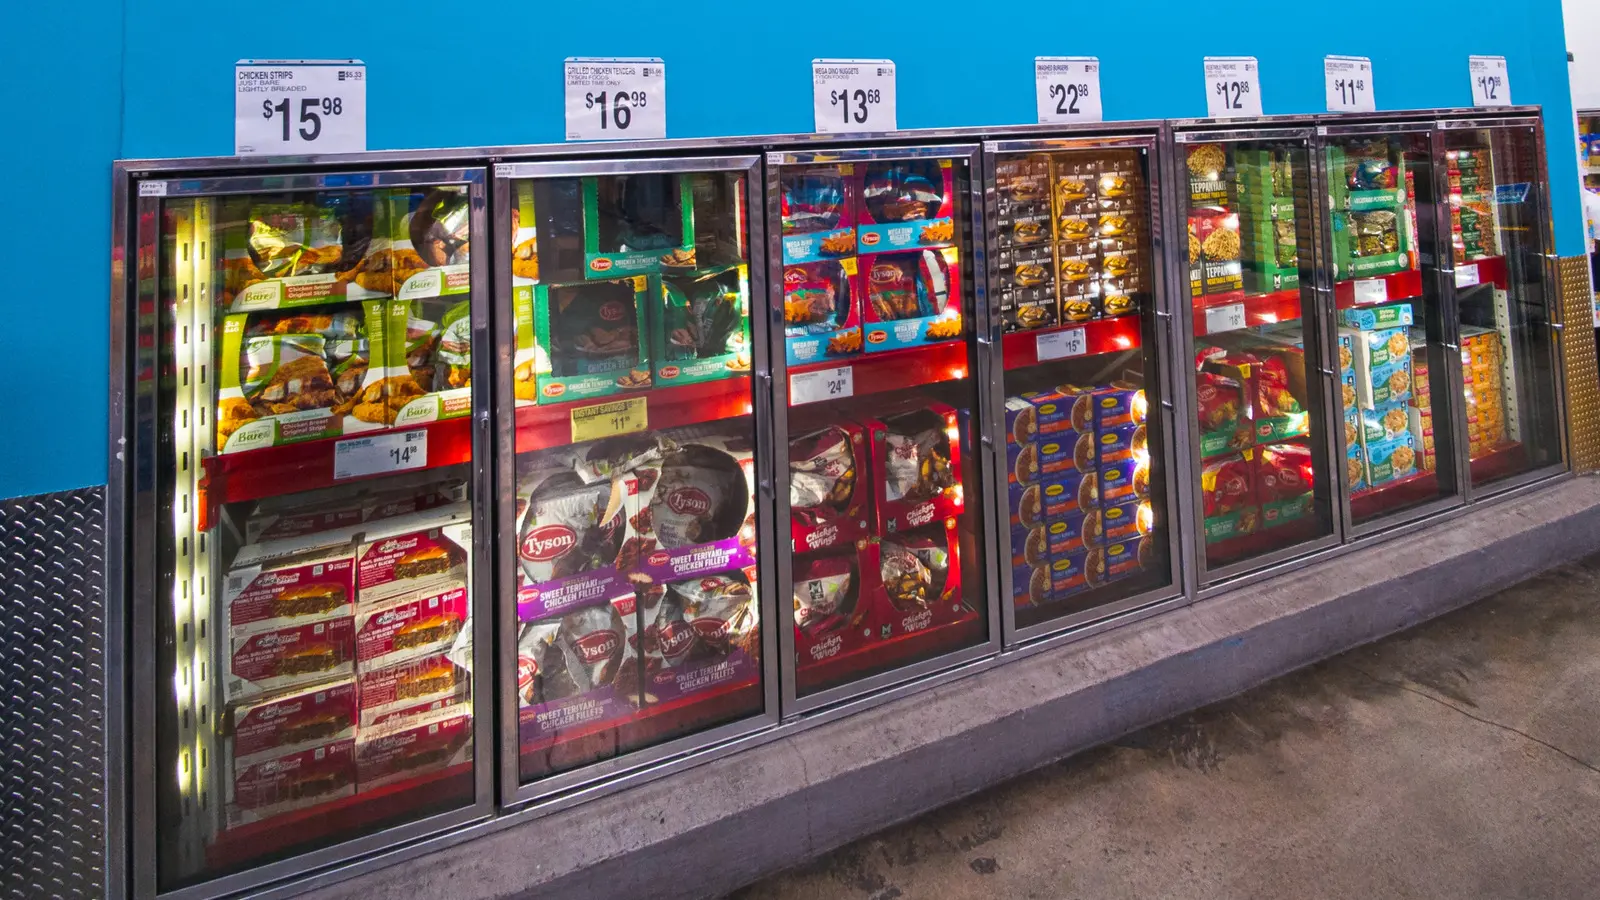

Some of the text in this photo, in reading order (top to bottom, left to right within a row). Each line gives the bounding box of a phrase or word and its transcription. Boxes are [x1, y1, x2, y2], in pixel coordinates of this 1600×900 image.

[238, 71, 293, 80] CHICKEN STRIPS
[567, 66, 636, 75] GRILLED CHICKEN TENDERS
[282, 418, 328, 430] Chicken Breast
[282, 425, 326, 436] Original Strips
[673, 493, 707, 510] Tyson
[906, 502, 935, 521] Chicken
[909, 510, 934, 527] Wings
[805, 525, 839, 544] Chicken
[809, 533, 837, 549] Wings
[525, 533, 572, 556] Tyson
[669, 549, 723, 567] SWEET TERIYAKI
[673, 555, 730, 574] CHICKEN FILLETS
[540, 579, 598, 602] SWEET TERIYAKI
[543, 584, 606, 609] CHICKEN FILLETS
[901, 609, 932, 628] Chicken
[904, 617, 931, 633] Wings
[810, 635, 842, 655] Chicken
[813, 643, 840, 660] Wings
[675, 660, 728, 684] SWEET TERIYAKI
[679, 667, 735, 691] CHICKEN FILLETS
[536, 709, 561, 723] SWEET
[562, 700, 596, 715] TERIYAKI
[541, 715, 575, 730] CHICKEN
[575, 705, 604, 720] FILLETS
